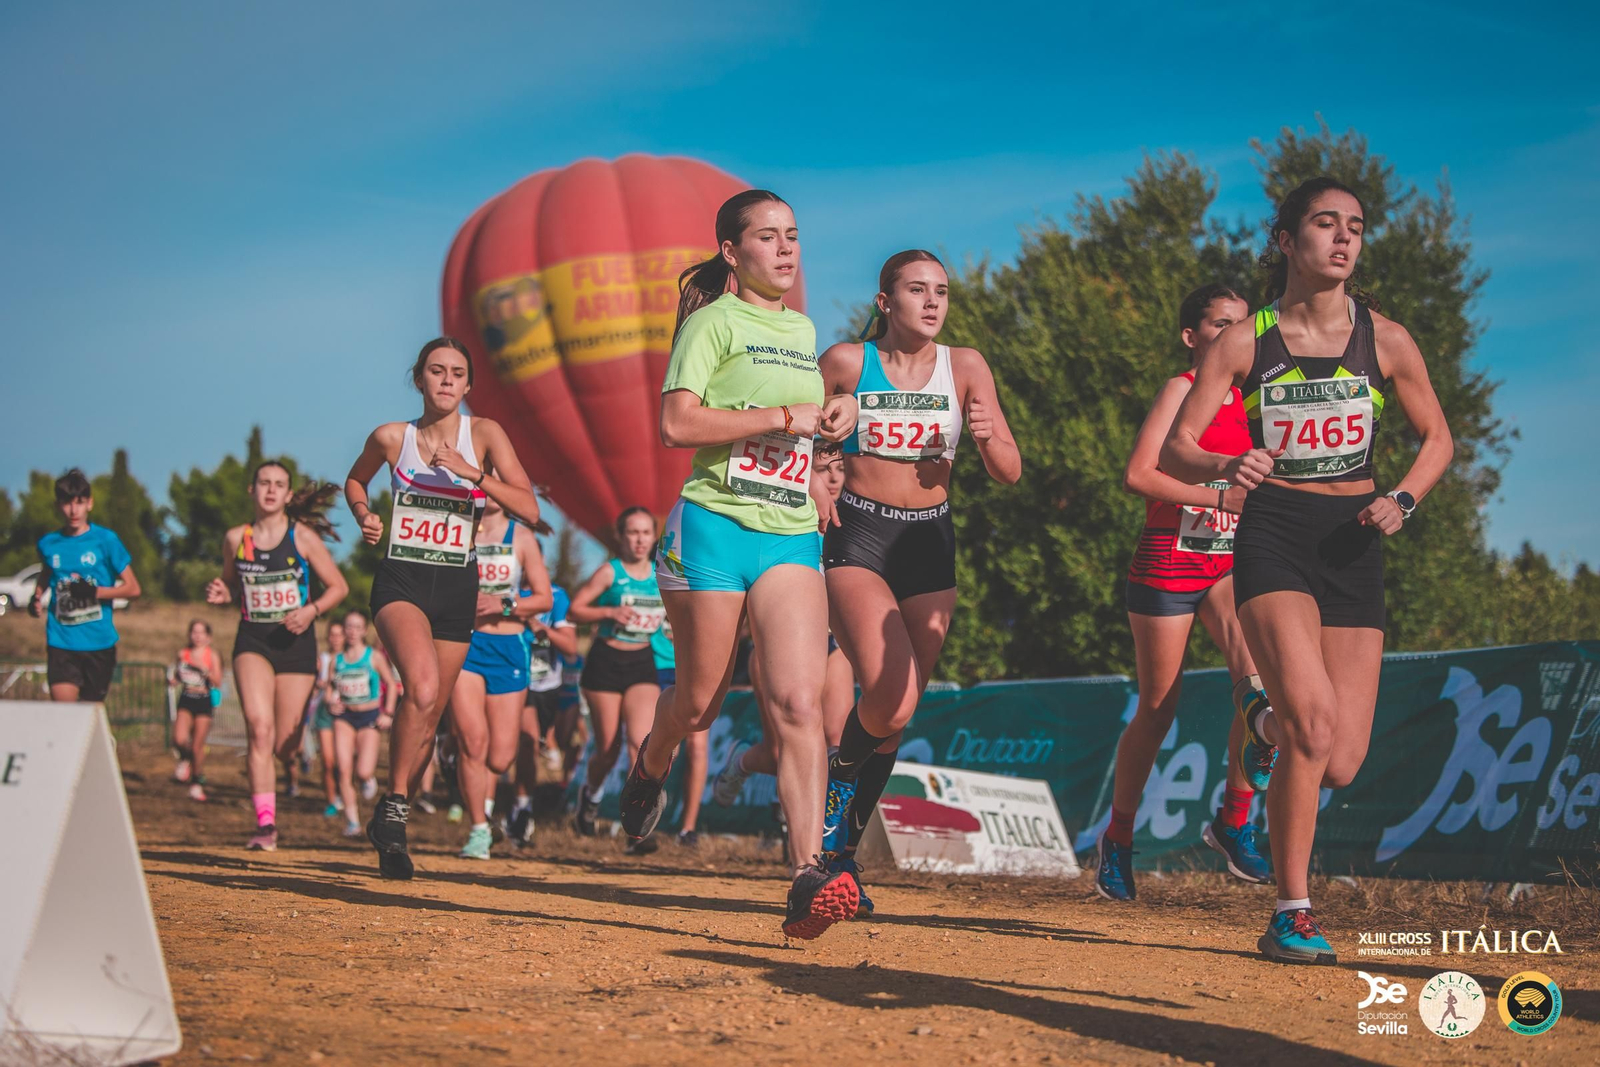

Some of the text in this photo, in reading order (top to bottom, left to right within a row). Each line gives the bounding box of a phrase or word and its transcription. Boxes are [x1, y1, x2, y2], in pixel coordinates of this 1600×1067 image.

[746, 345, 778, 355] MAURI
[752, 357, 780, 370] Escuela
[1292, 383, 1344, 398] ITÁLICA
[867, 422, 943, 449] 5521
[1273, 413, 1365, 452] 7465
[739, 440, 809, 485] 5522
[881, 506, 938, 521] UNDER
[398, 517, 464, 548] 5401
[251, 589, 296, 608] 5396
[979, 802, 1068, 852] ITÁLICA
